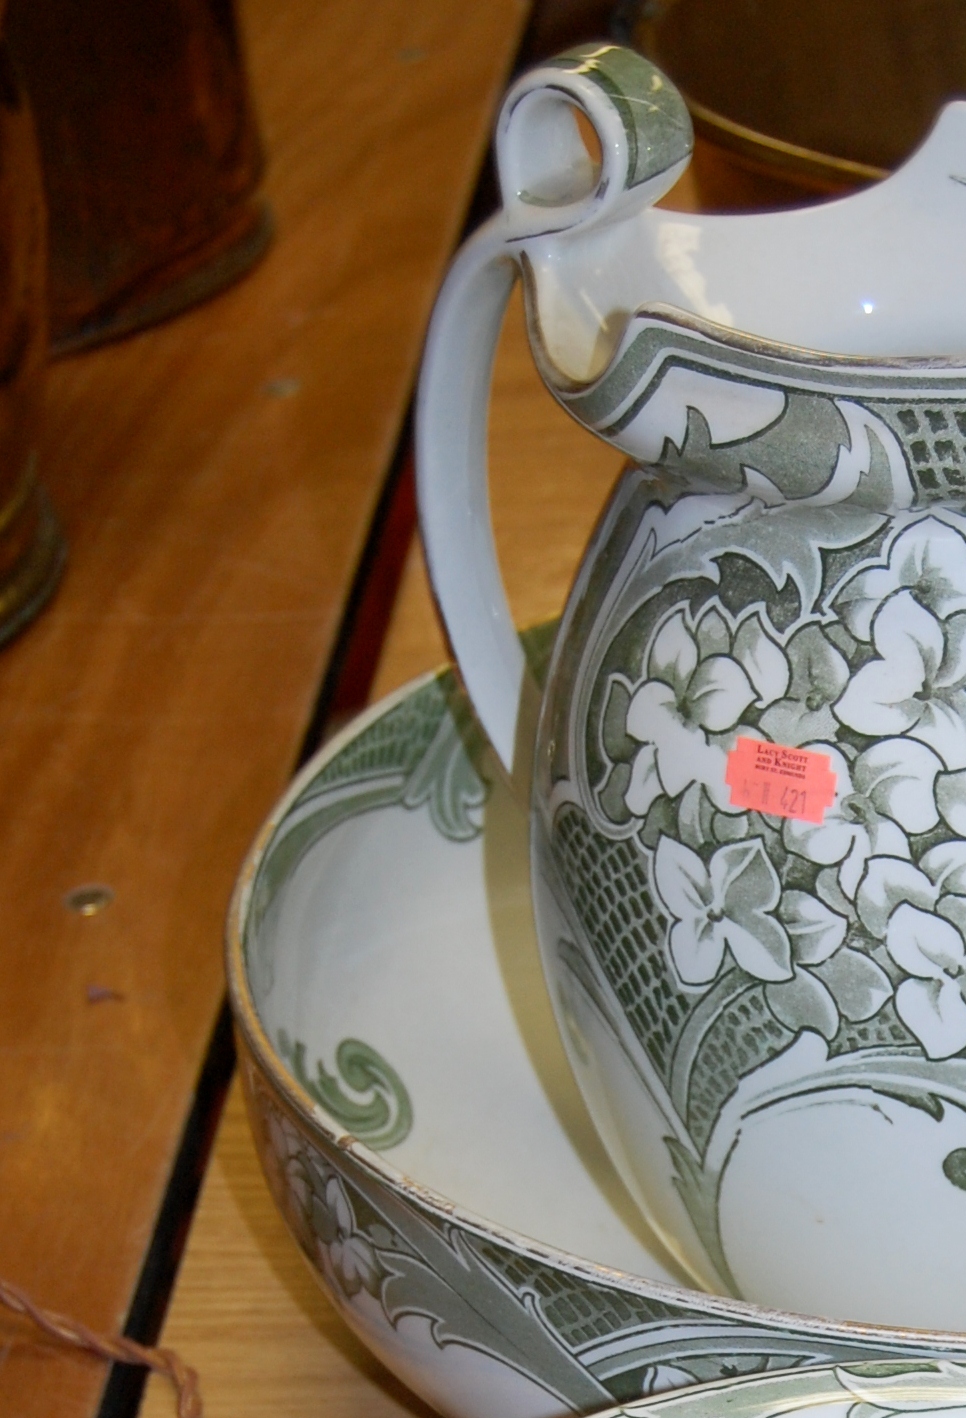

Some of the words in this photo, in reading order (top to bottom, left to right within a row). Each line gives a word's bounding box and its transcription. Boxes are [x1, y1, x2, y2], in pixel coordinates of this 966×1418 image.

[781, 750, 808, 763] SCOTT
[756, 757, 772, 765] AND
[774, 758, 806, 772] KNIGHT
